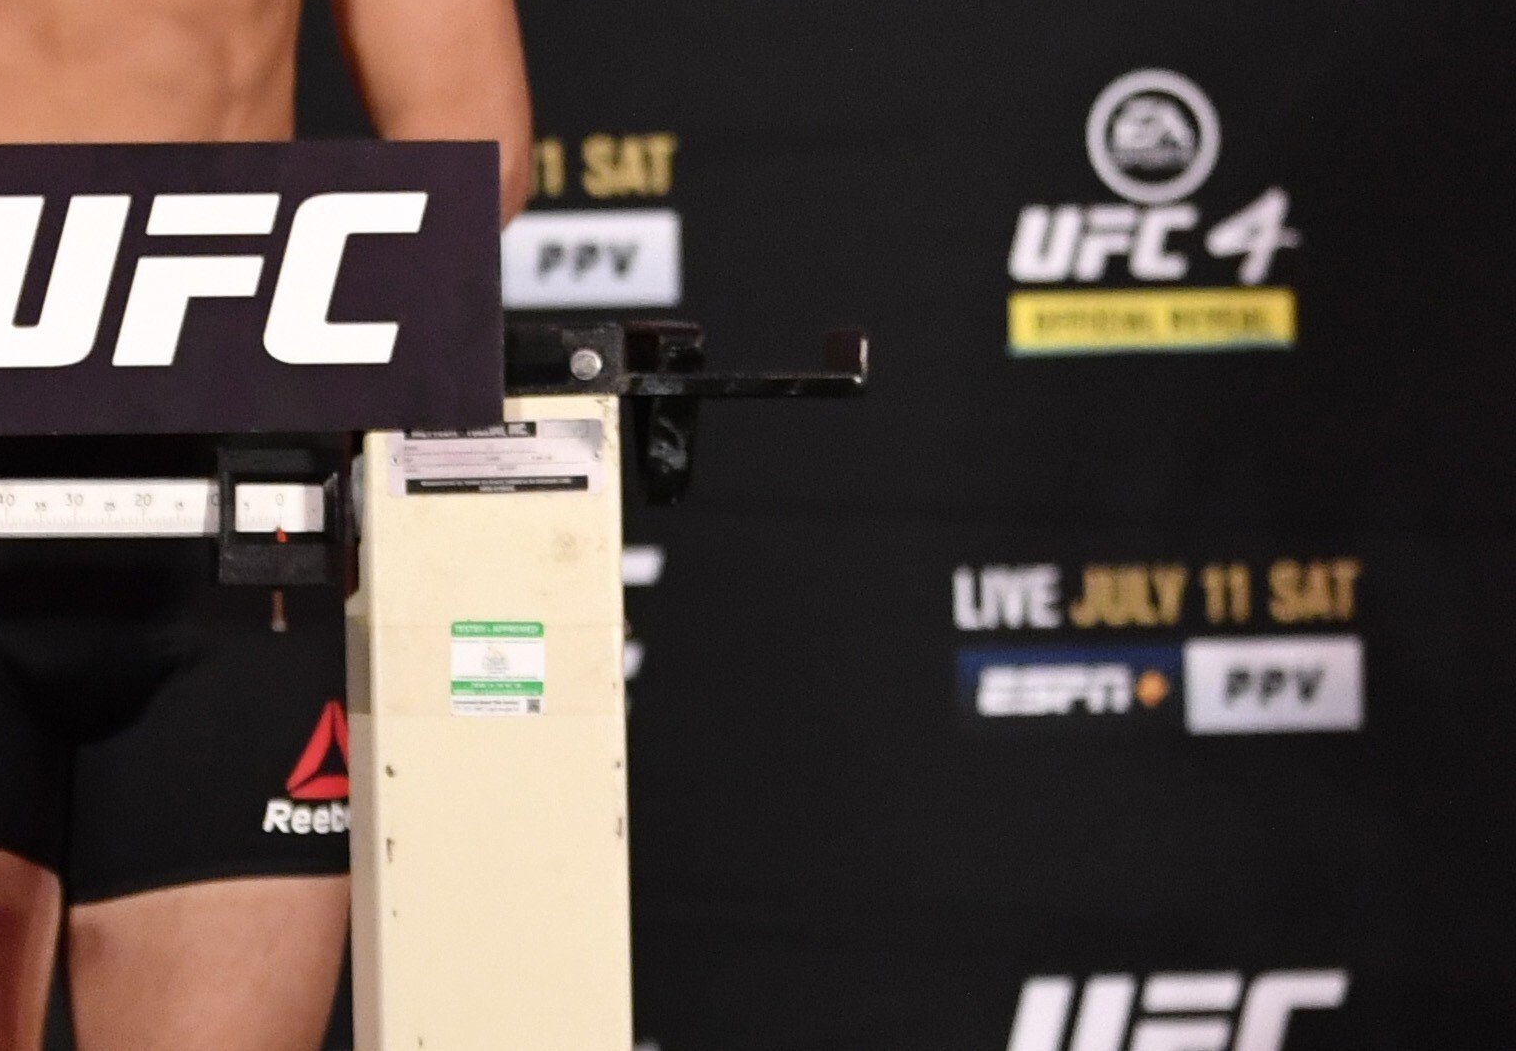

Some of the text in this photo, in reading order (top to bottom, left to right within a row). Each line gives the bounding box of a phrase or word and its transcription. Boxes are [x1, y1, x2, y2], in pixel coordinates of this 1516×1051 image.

[581, 133, 676, 197] SAT
[536, 240, 638, 281] PPV
[1008, 187, 1300, 285] UFC 4
[65, 493, 84, 506] 30
[135, 493, 152, 506] 20
[952, 558, 1362, 630] LIVE JULY 11 SAT
[1223, 664, 1328, 710] PPV
[1006, 969, 1349, 1051] UFC
